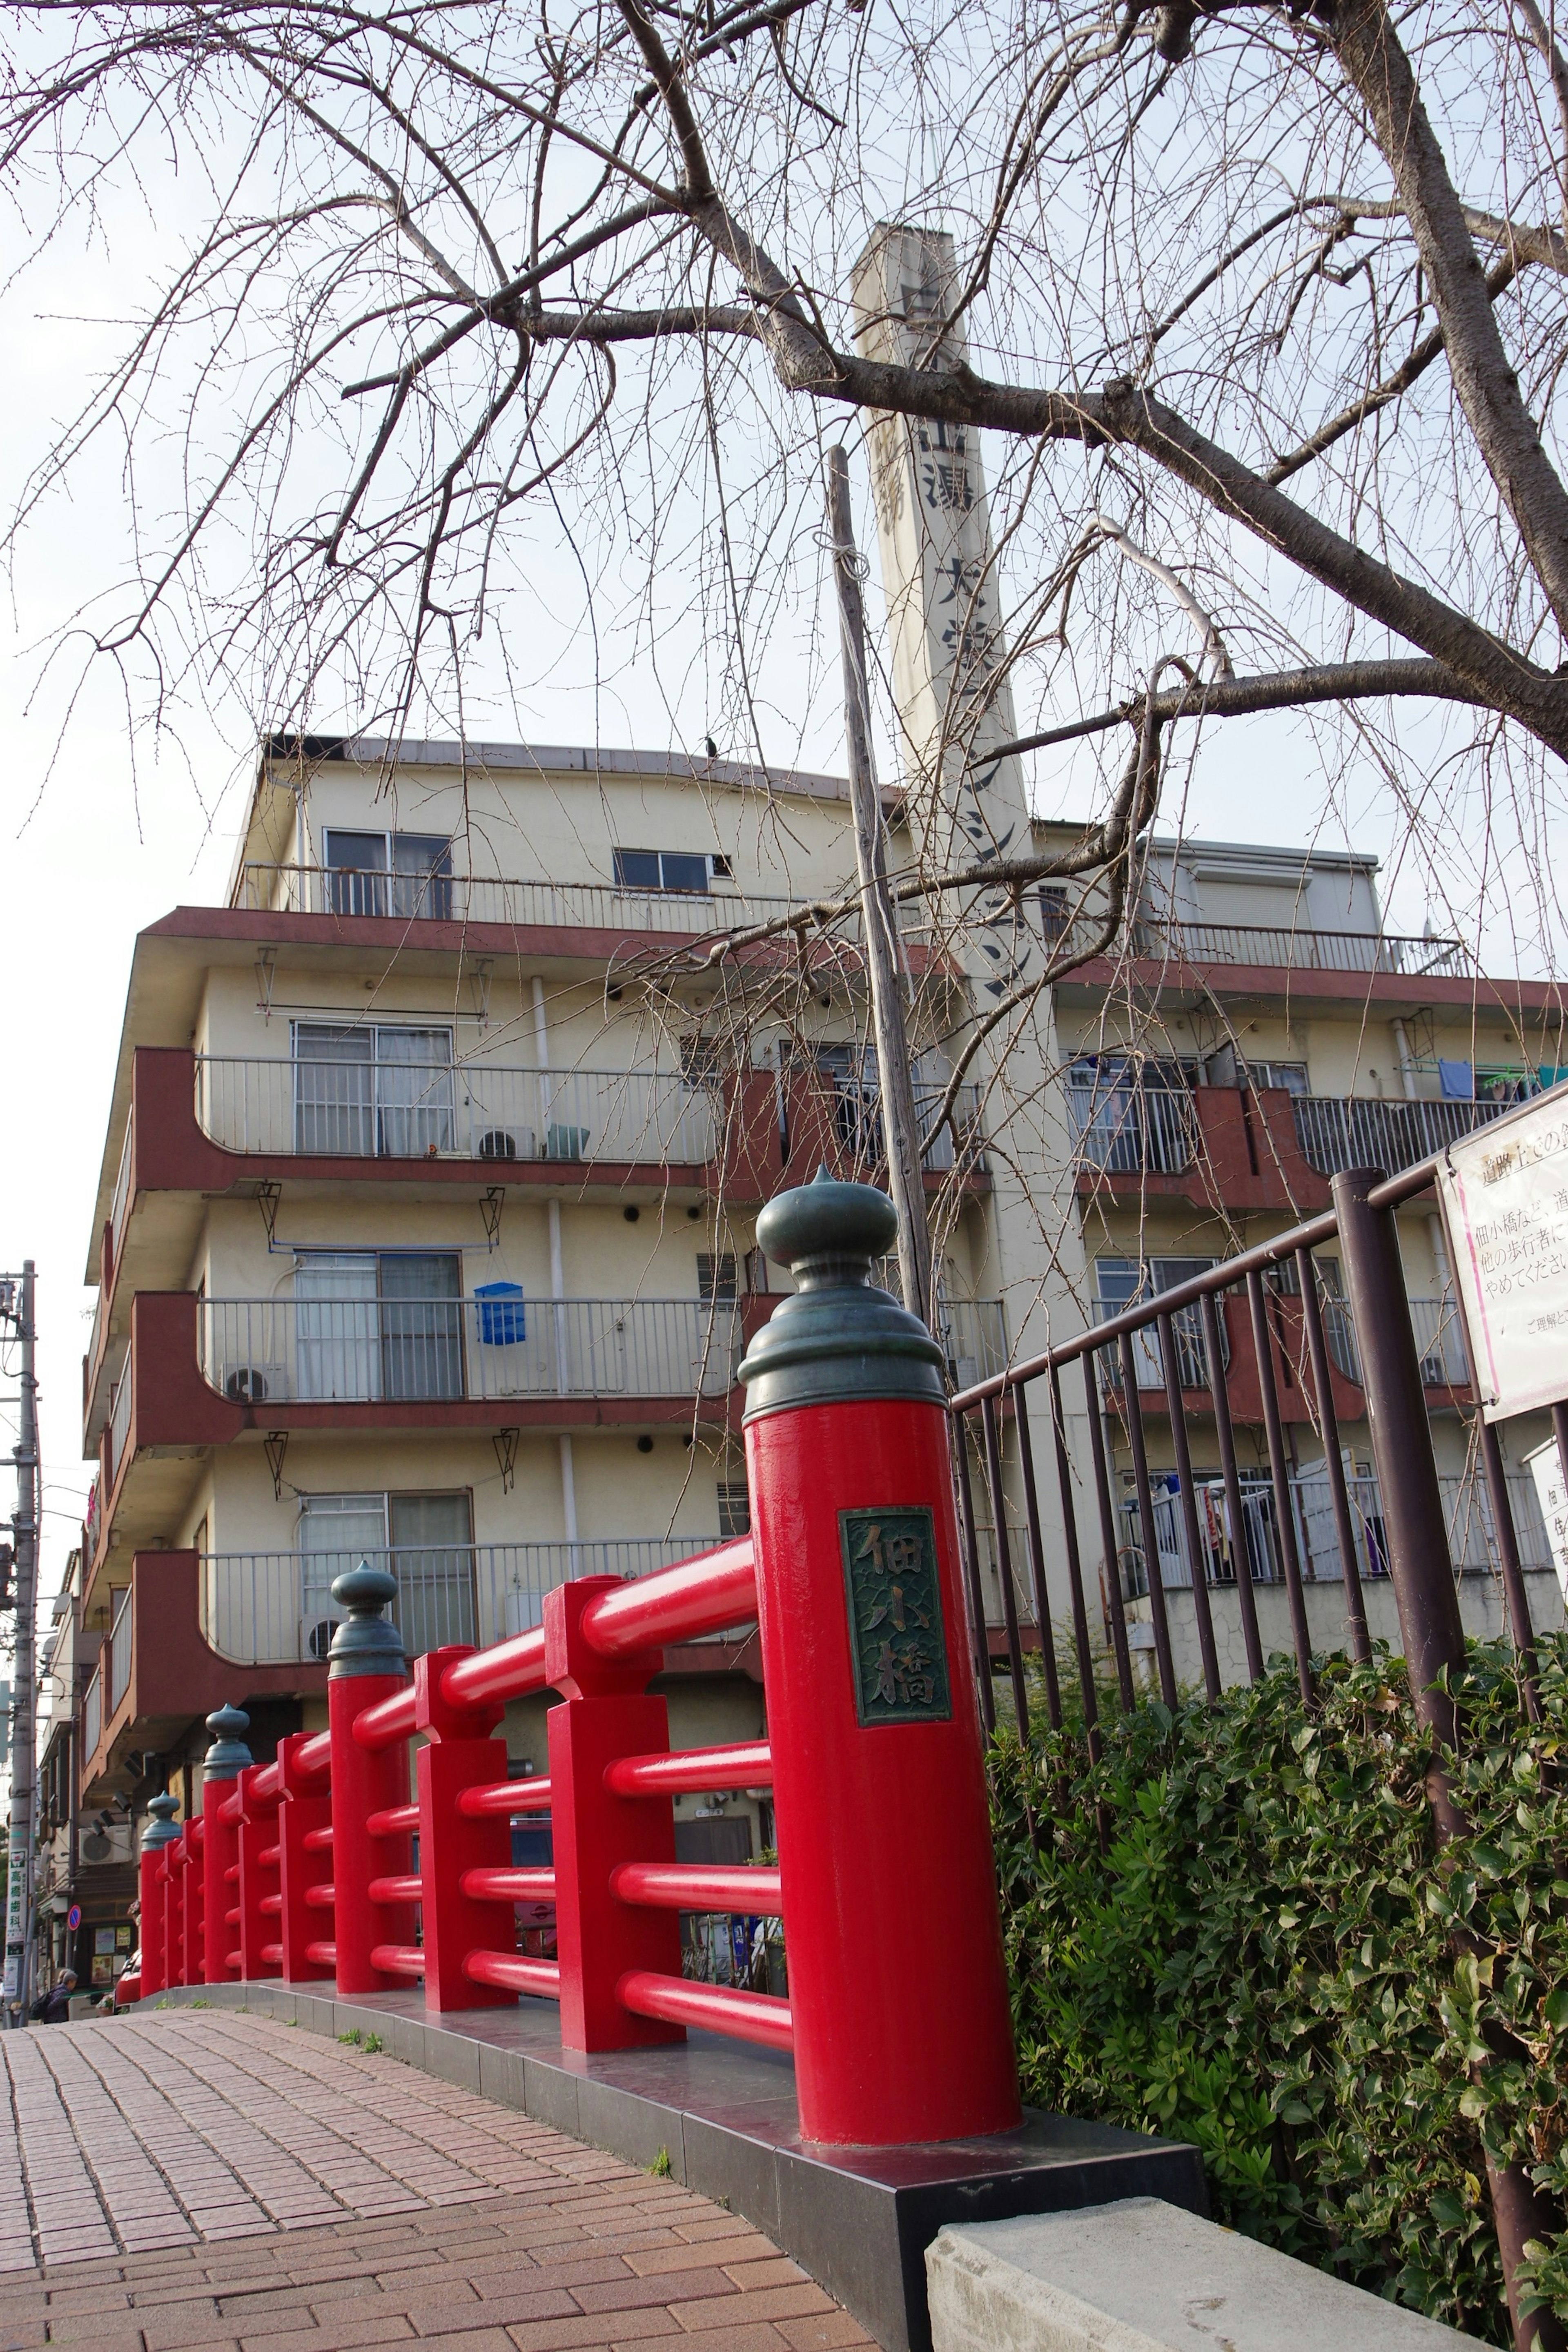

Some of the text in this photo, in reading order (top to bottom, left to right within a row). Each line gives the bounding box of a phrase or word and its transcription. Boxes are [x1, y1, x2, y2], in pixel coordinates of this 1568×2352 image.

[855, 1524, 935, 1705] 佃小橋
[10, 1871, 21, 1928] 高橋歯科
